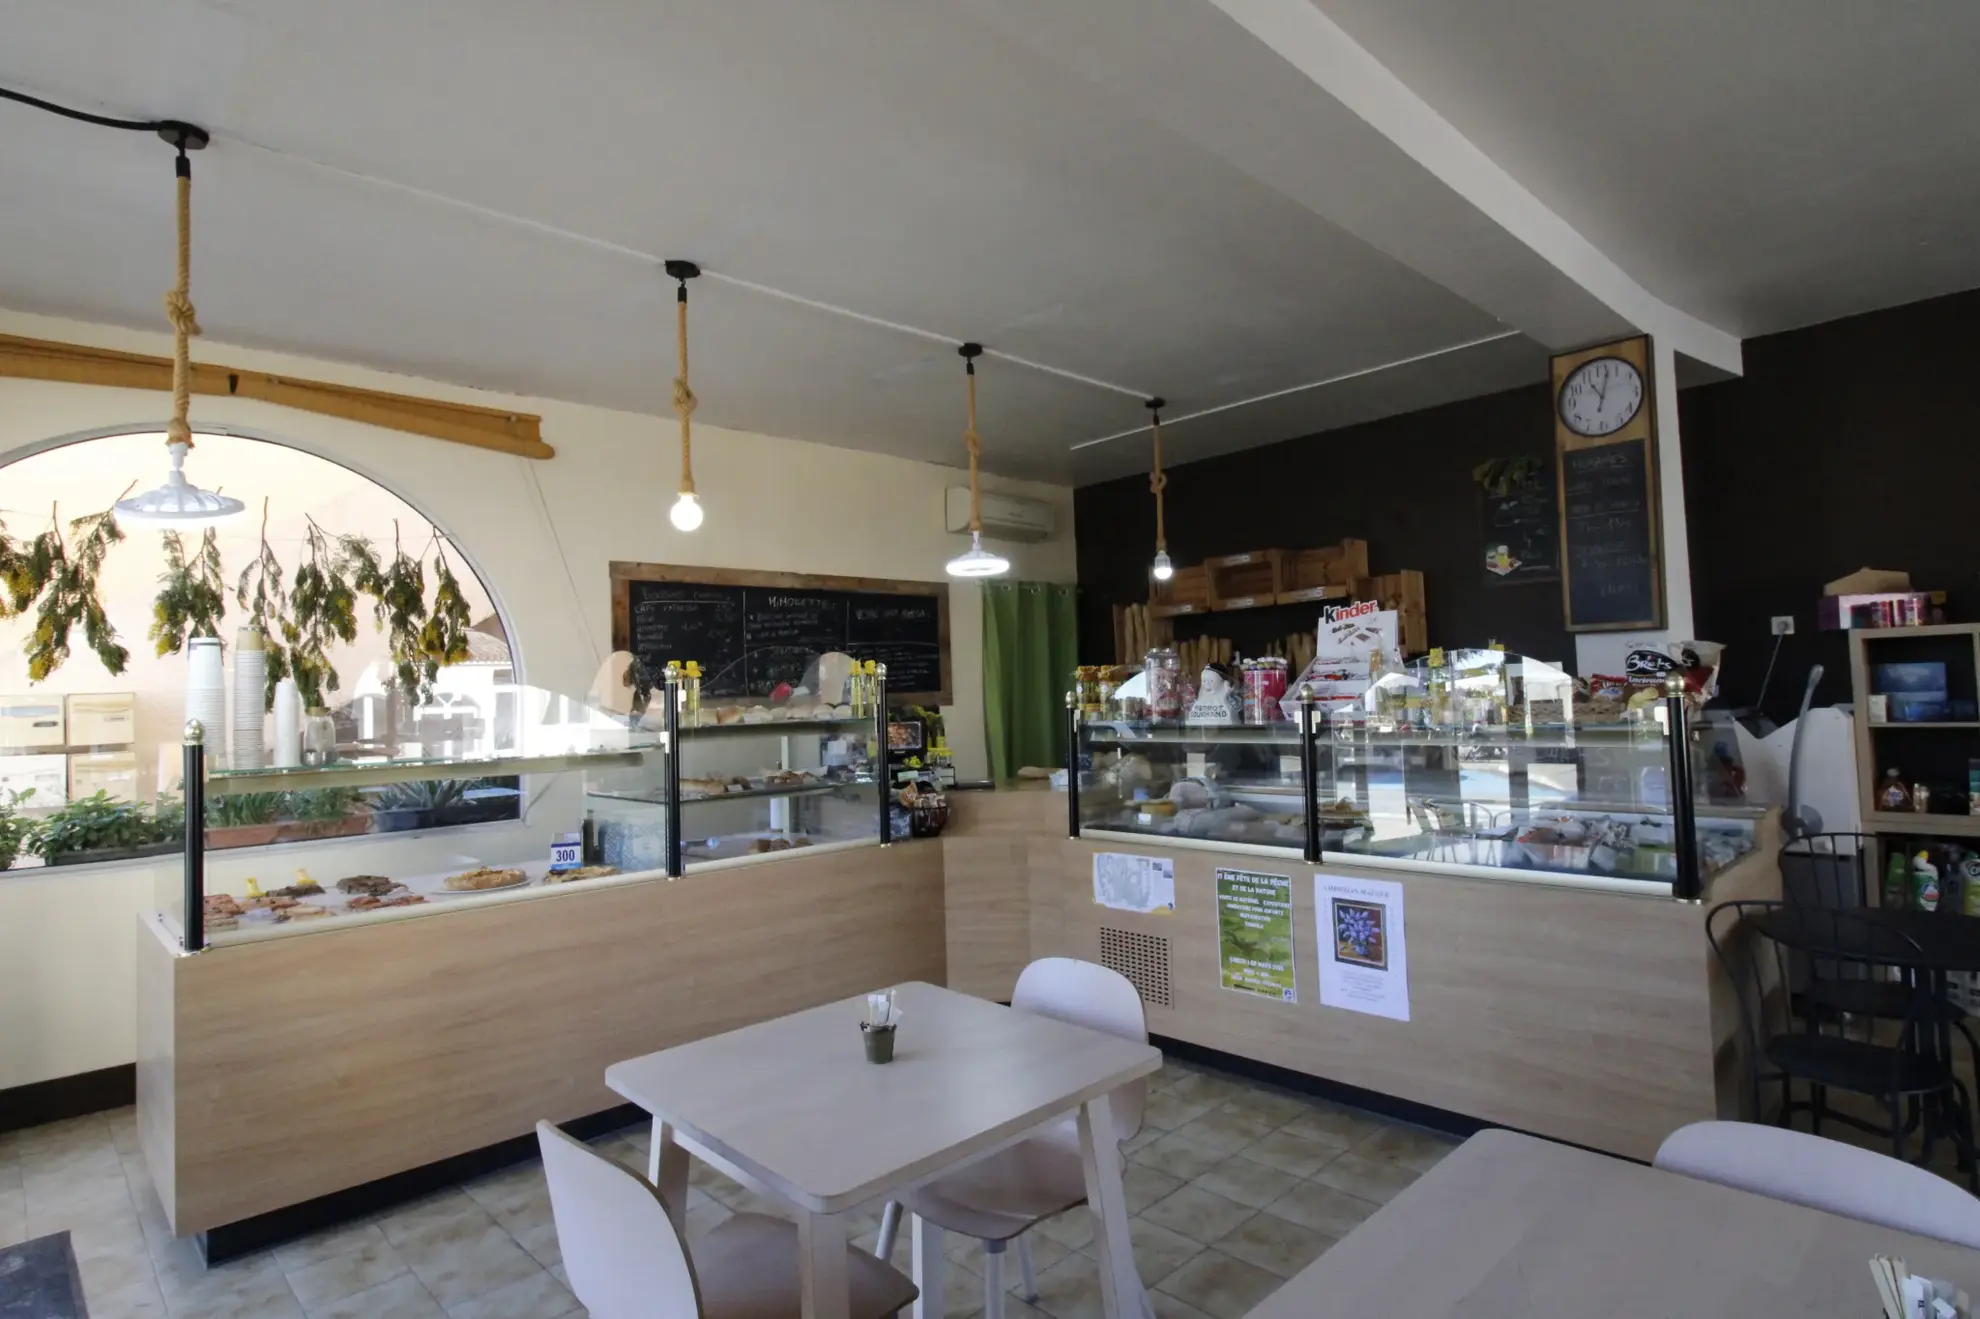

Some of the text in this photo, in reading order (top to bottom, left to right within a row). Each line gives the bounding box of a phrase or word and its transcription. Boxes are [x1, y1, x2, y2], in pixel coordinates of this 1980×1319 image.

[1571, 384, 1582, 396] 10
[1568, 396, 1577, 411] 9
[1325, 600, 1376, 624] Kinder
[1627, 655, 1673, 671] Brets
[555, 849, 575, 862] 300
